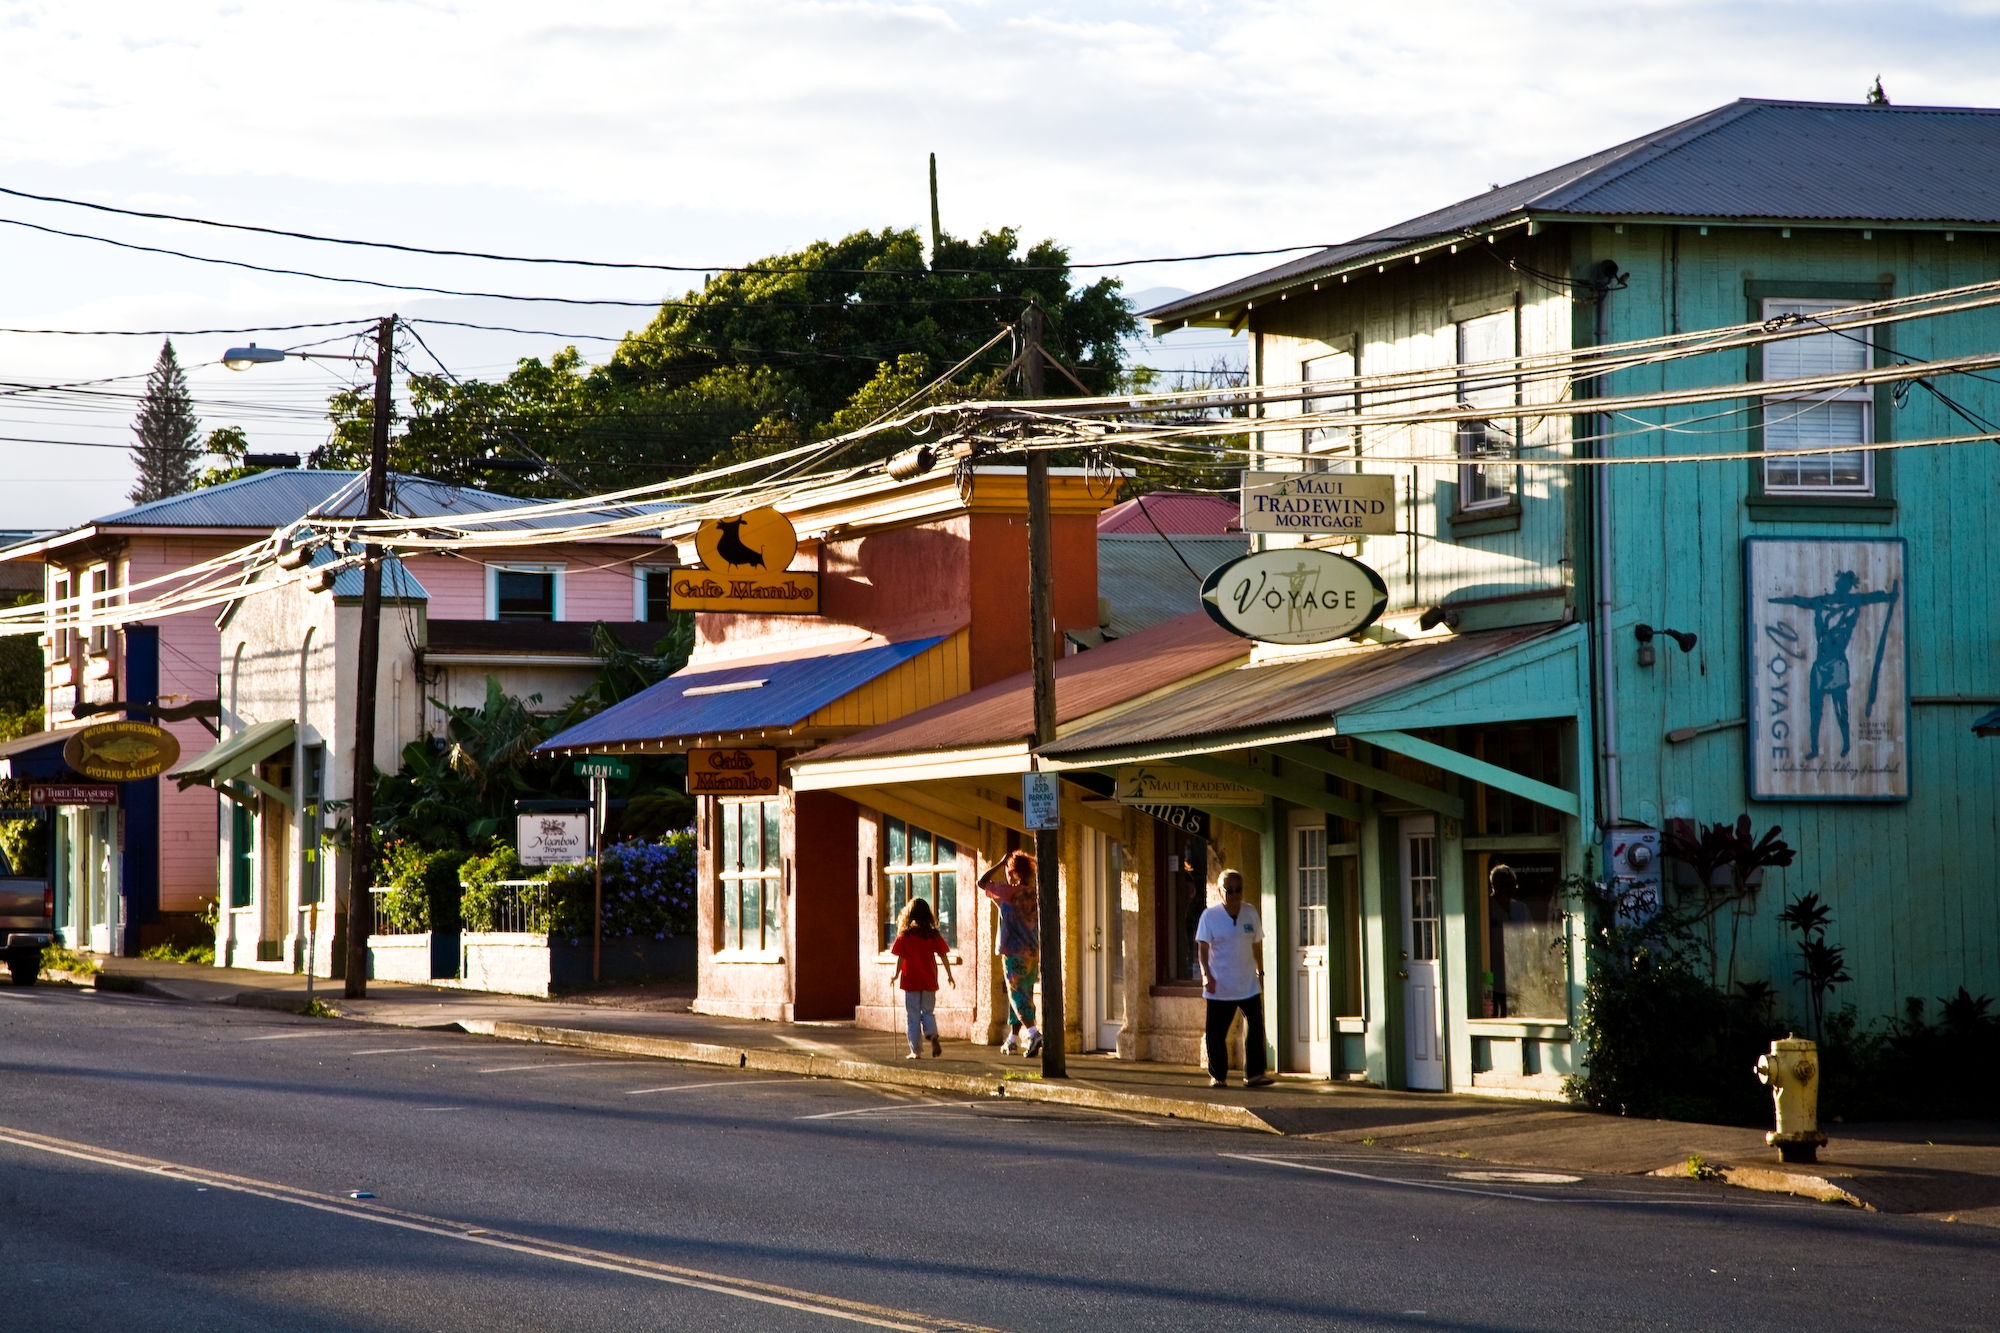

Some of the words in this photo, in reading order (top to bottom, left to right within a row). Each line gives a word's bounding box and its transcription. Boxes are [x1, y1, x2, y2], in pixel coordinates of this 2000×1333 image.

[1296, 479, 1343, 494] MAUI
[1254, 495, 1385, 515] TRADEWIND
[1275, 514, 1363, 528] MORTGAGE
[725, 580, 814, 600] Mambo
[1233, 570, 1356, 614] VOYAGE
[1765, 621, 1806, 759] VOYAGE
[83, 724, 115, 740] NATURAL
[116, 723, 162, 738] IMPRESSIONS
[85, 766, 123, 779] GYOTAKU
[125, 762, 161, 778] GALLERY
[581, 764, 612, 777] AKONI
[692, 770, 773, 791] Mambo
[1150, 780, 1181, 791] MAUI
[46, 787, 71, 797] THREE
[72, 787, 115, 798] TREASURES
[1032, 783, 1050, 793] HOUR
[1028, 792, 1054, 802] PARKING
[527, 834, 579, 848] Moonbow
[542, 847, 568, 856] Tropics
